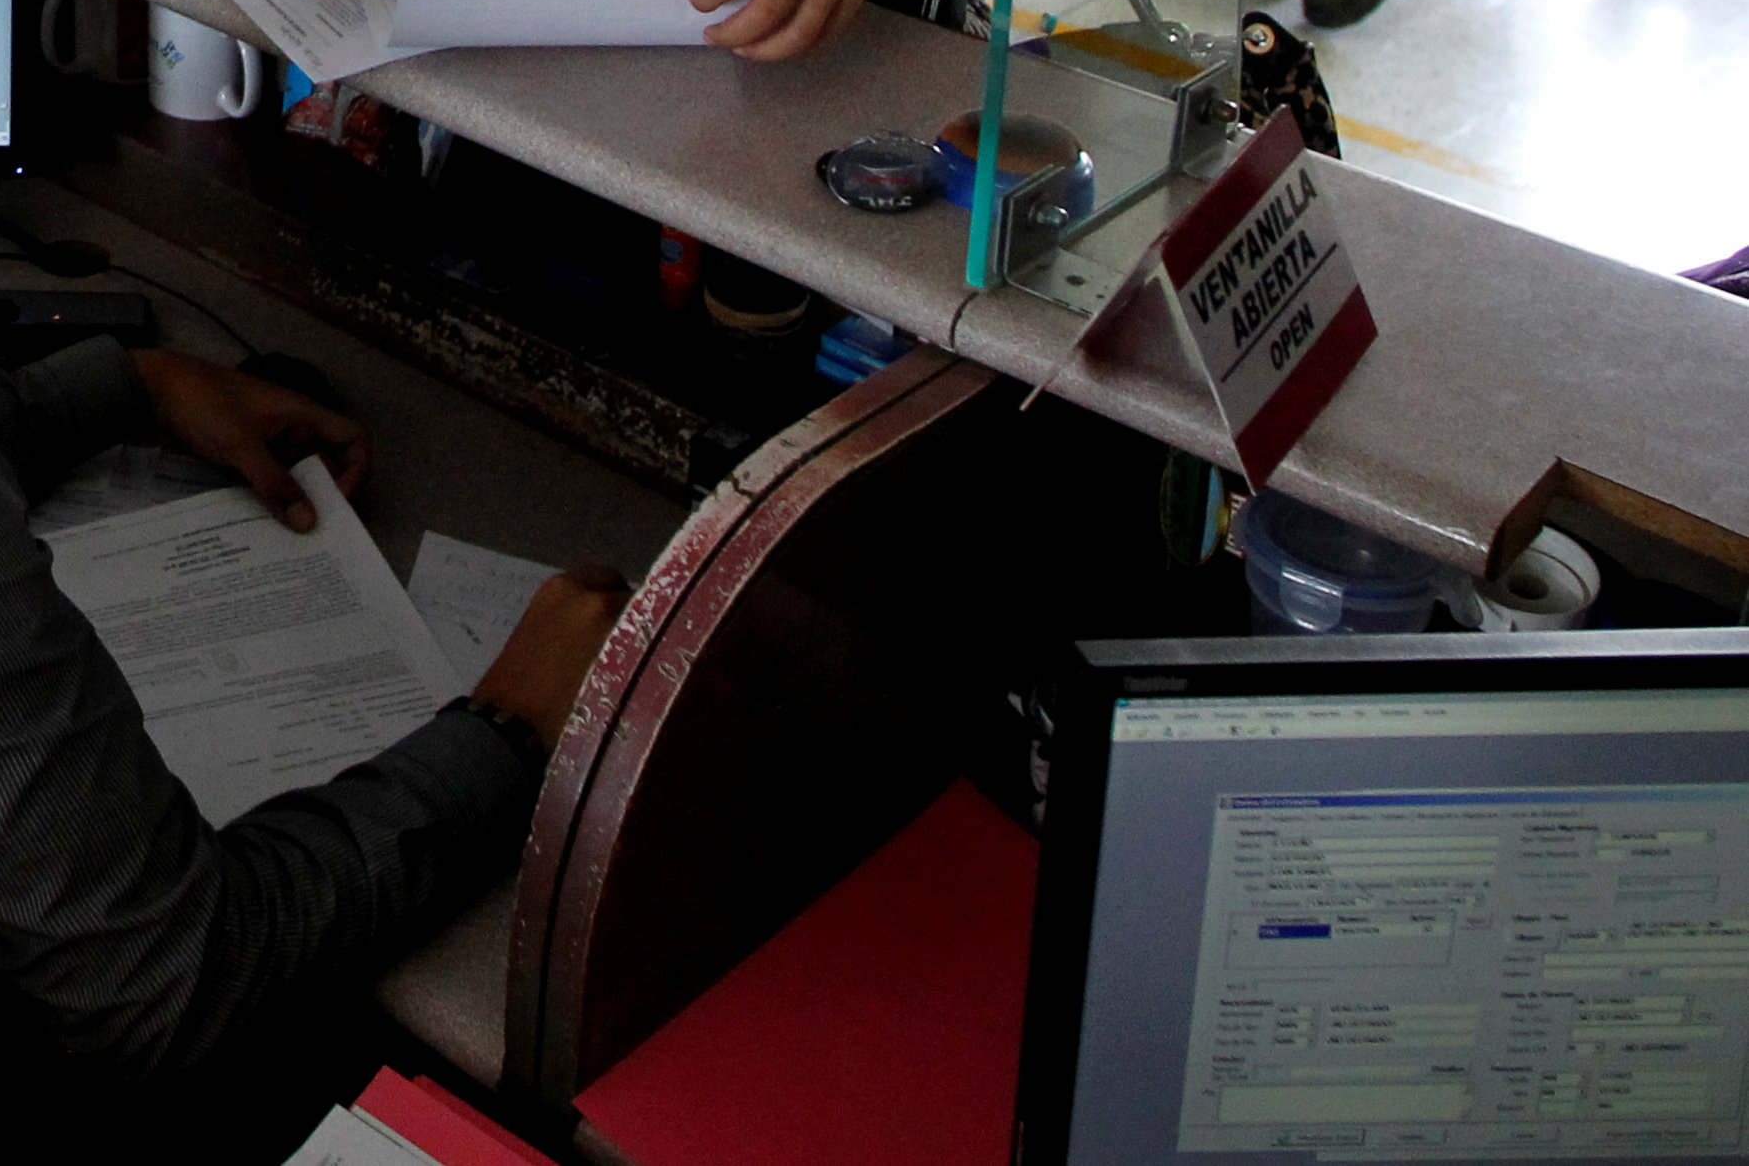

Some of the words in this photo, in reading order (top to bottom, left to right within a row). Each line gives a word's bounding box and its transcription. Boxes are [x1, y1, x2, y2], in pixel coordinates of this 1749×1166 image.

[1190, 168, 1318, 324] VENTANILLA
[1232, 230, 1317, 347] ABIERTA
[1270, 304, 1315, 370] OPEN
